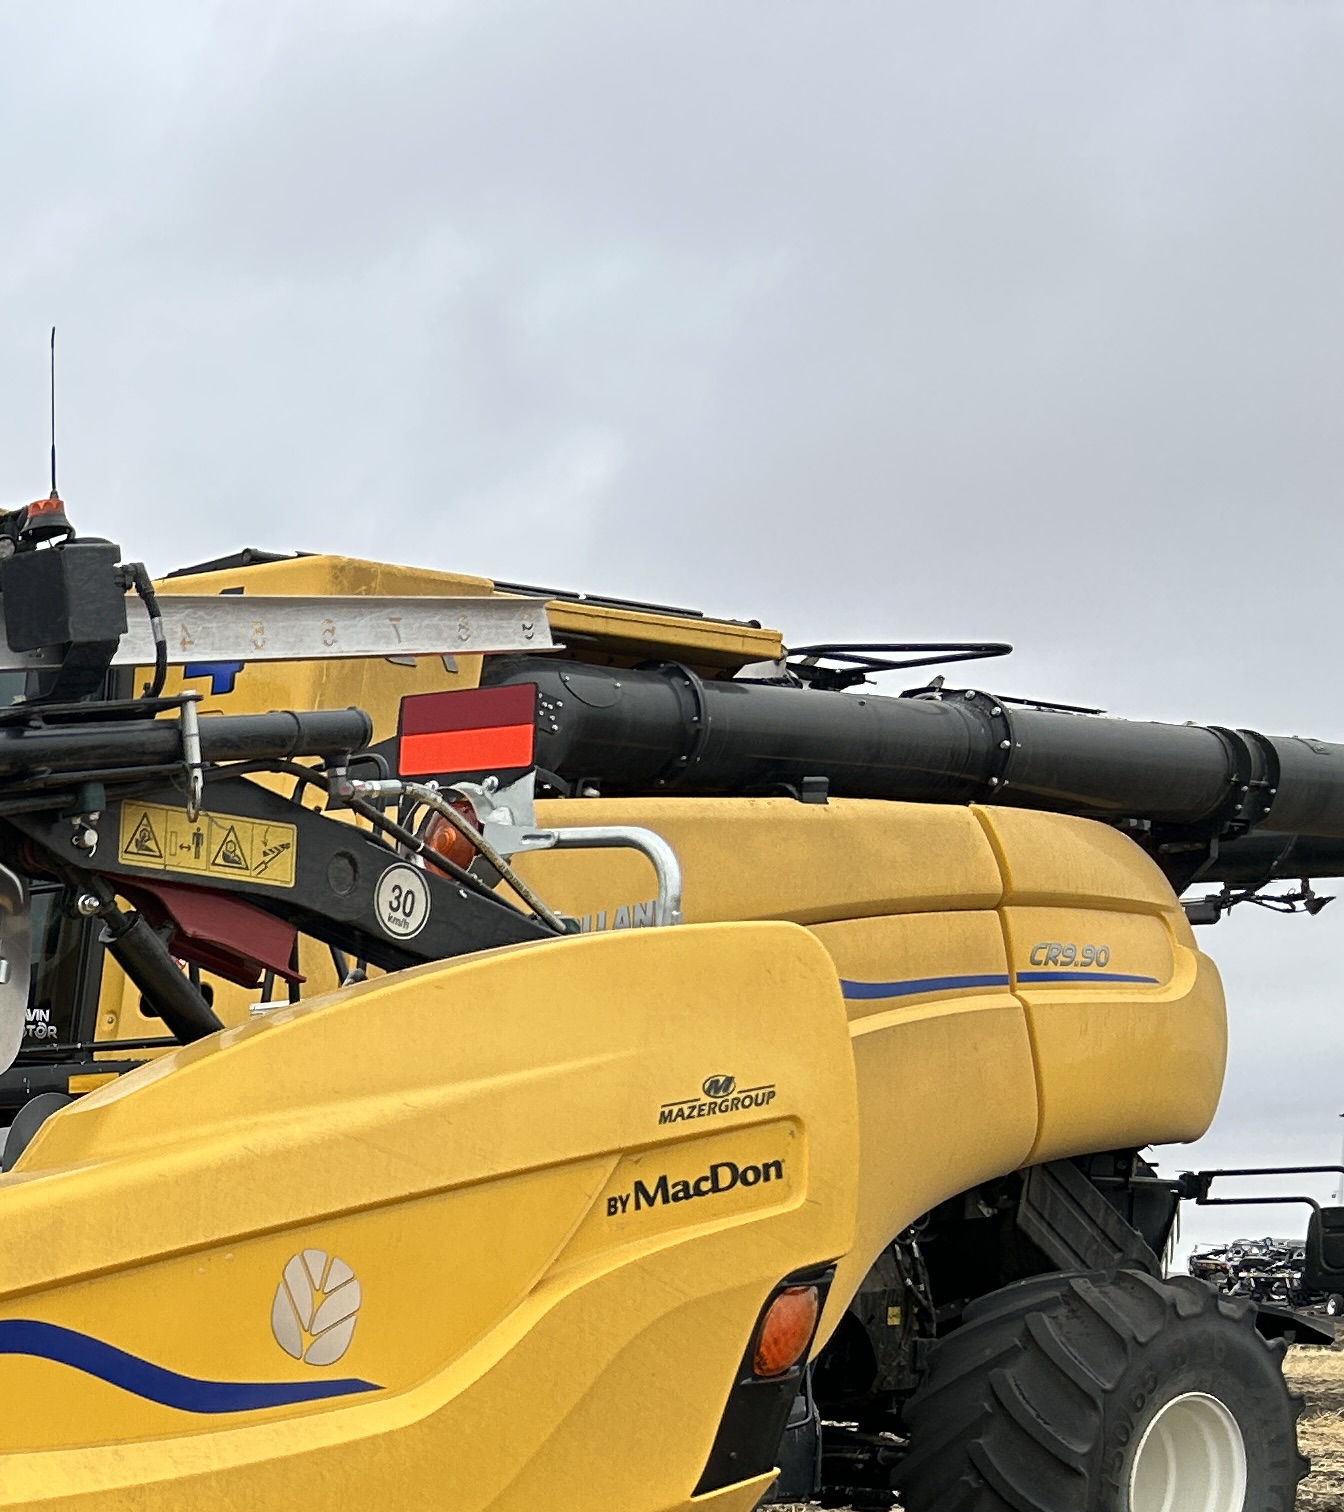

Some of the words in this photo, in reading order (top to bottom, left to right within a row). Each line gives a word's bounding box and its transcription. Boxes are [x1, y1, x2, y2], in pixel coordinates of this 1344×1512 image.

[388, 884, 415, 918] 30
[387, 913, 410, 930] km/h
[1029, 942, 1110, 968] CR9.90
[658, 1090, 776, 1125] MAZERGROUP
[606, 1193, 630, 1217] BY
[634, 1158, 784, 1211] MacDon
